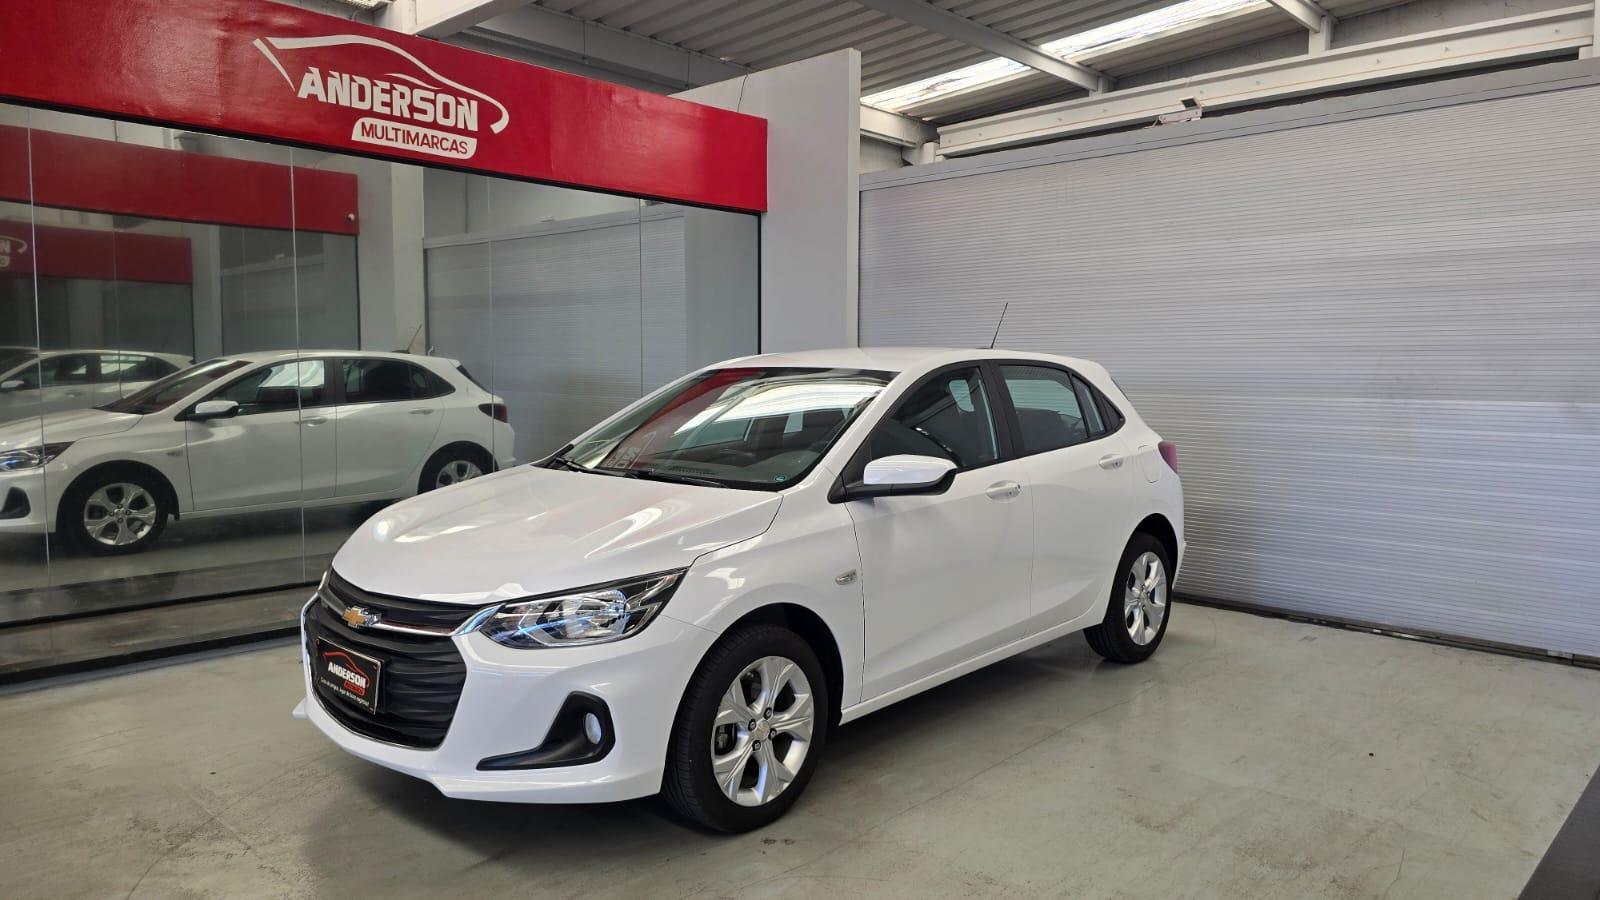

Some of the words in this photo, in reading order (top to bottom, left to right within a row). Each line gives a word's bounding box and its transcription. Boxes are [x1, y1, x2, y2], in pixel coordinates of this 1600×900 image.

[297, 66, 479, 132] ANDERSON
[361, 121, 469, 155] MULTIMARCAS
[327, 661, 367, 689] ANDERSON
